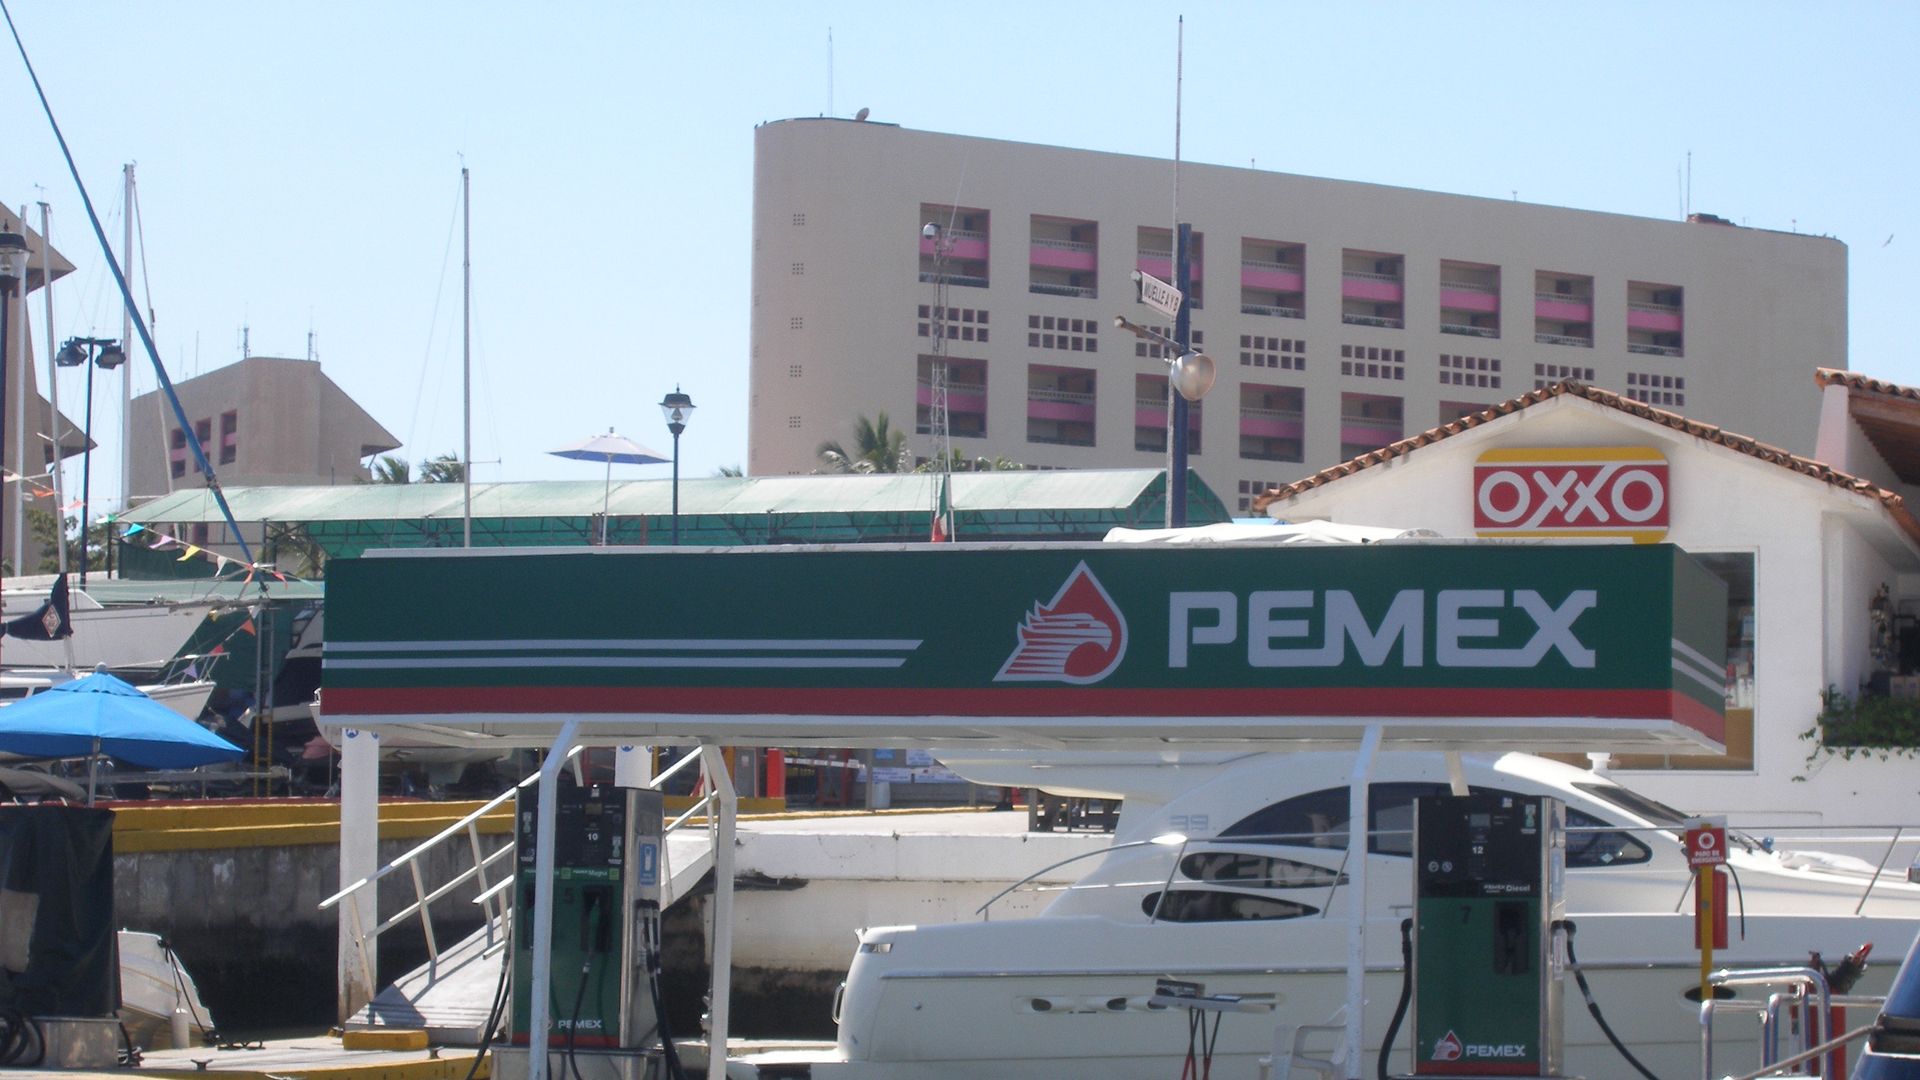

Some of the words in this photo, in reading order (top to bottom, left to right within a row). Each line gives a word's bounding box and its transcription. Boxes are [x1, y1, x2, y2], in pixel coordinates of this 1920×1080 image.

[1478, 467, 1664, 526] OXXO
[1168, 589, 1597, 668] PEMEX
[587, 833, 599, 841] 10
[1472, 846, 1484, 855] 12
[1505, 884, 1531, 892] Diesel
[1460, 905, 1473, 925] 7
[1466, 1044, 1526, 1057] PEMEX
